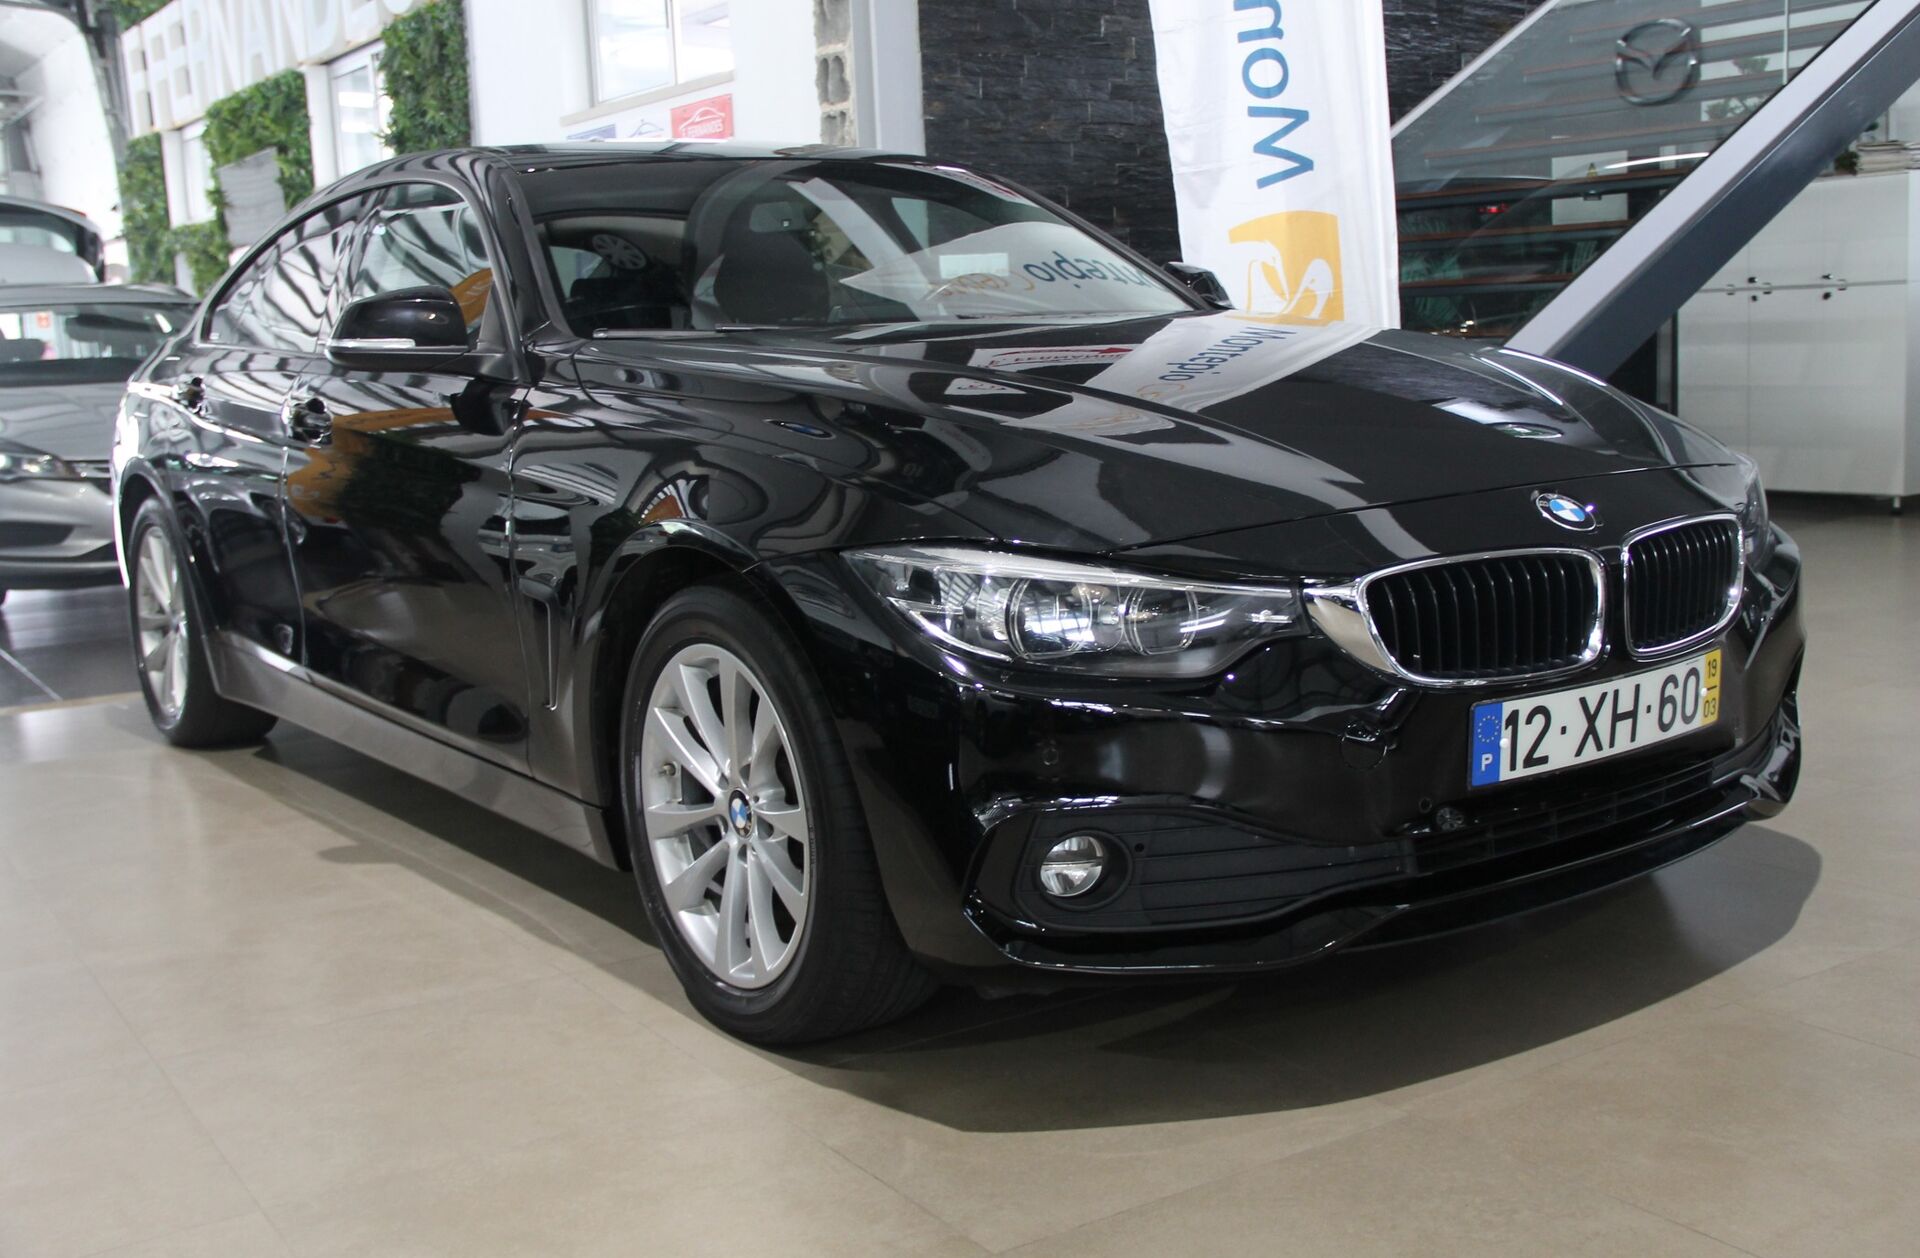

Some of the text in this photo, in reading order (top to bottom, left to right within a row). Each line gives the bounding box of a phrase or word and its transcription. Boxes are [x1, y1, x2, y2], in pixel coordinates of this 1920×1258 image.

[1158, 326, 1298, 382] Montepio
[1707, 658, 1719, 679] 19
[1703, 696, 1718, 718] 03
[1480, 753, 1494, 772] P
